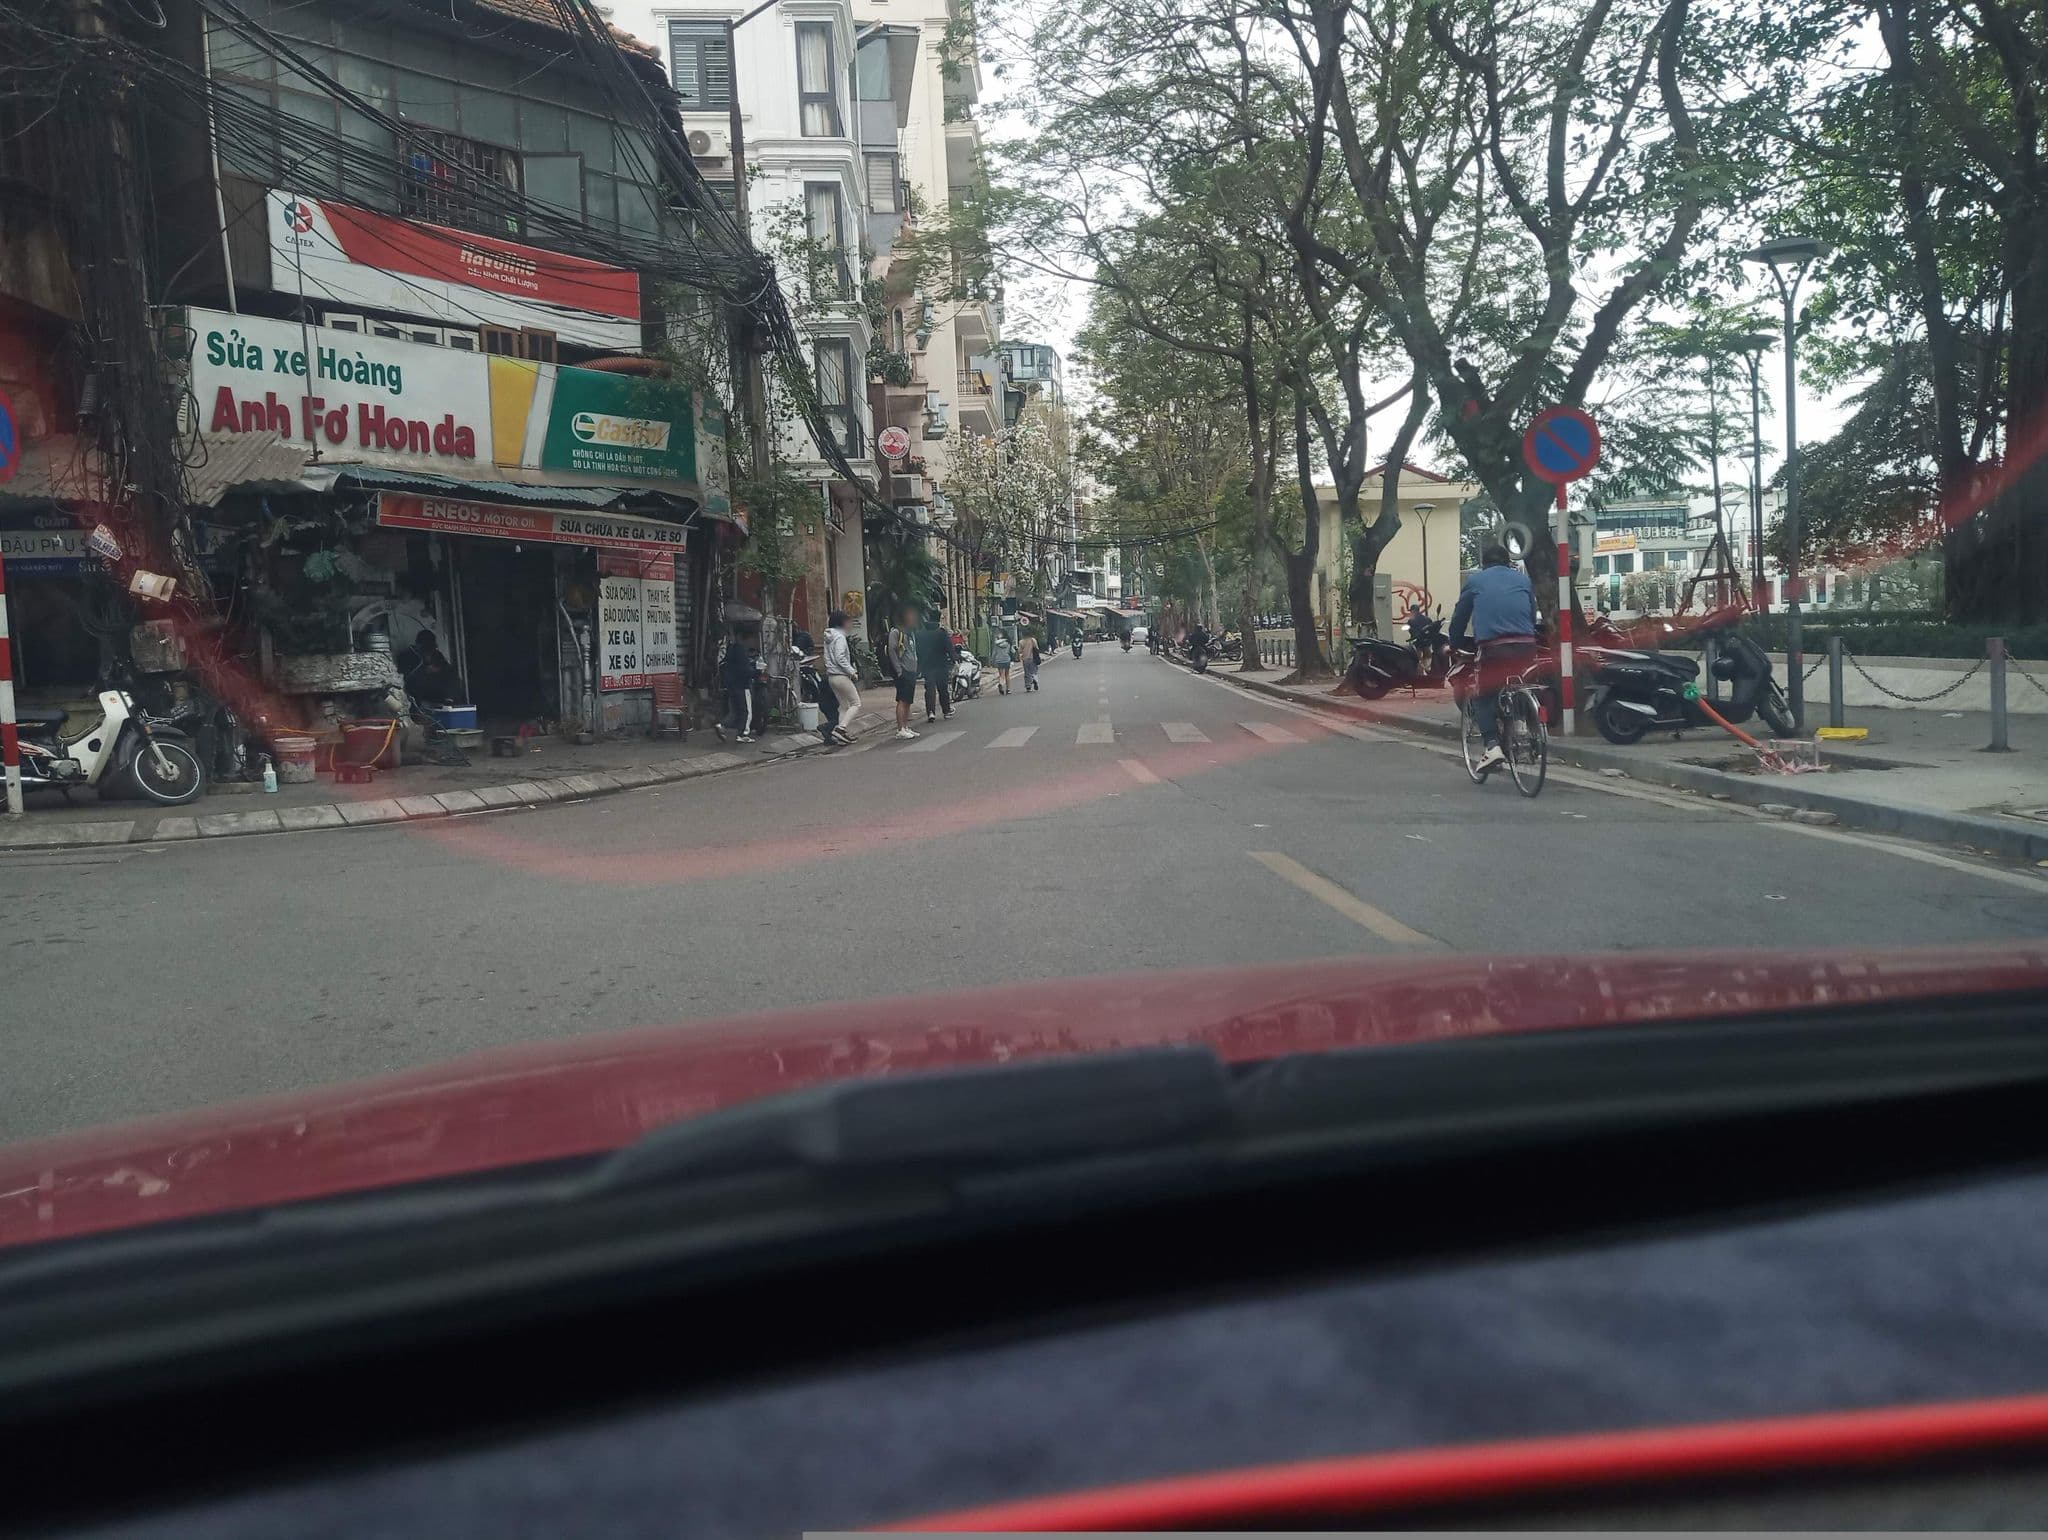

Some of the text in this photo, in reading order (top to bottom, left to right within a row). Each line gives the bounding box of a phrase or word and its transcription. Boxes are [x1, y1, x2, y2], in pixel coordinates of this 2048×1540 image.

[285, 236, 315, 249] CATEX
[207, 329, 402, 395] Sửa xe Hoàng
[211, 385, 291, 439] Anh
[572, 448, 593, 459] KHÔNG
[422, 501, 535, 529] ENEOS MOTOR OIL
[616, 526, 629, 538] XE
[632, 528, 645, 540] GA
[654, 530, 667, 541] XE
[608, 630, 636, 645] XE GA
[609, 651, 636, 670] XE SỐ
